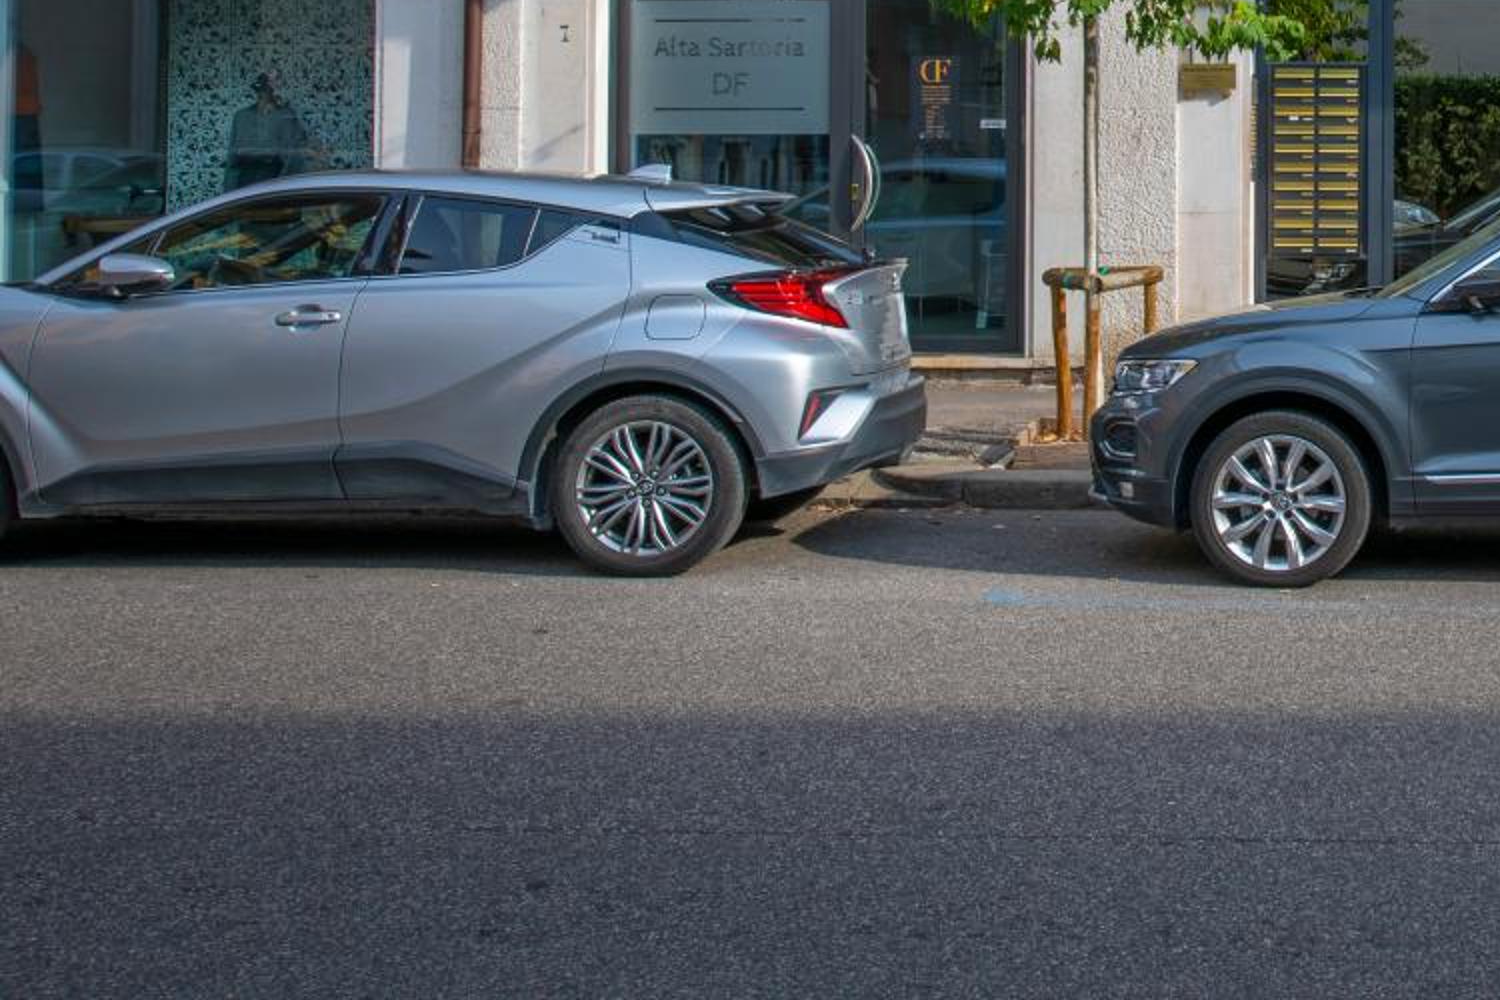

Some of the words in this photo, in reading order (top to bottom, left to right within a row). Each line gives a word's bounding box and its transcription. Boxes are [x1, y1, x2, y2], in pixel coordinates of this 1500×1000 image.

[654, 35, 701, 57] Alta
[708, 35, 805, 57] Sartoria
[711, 72, 750, 96] DF
